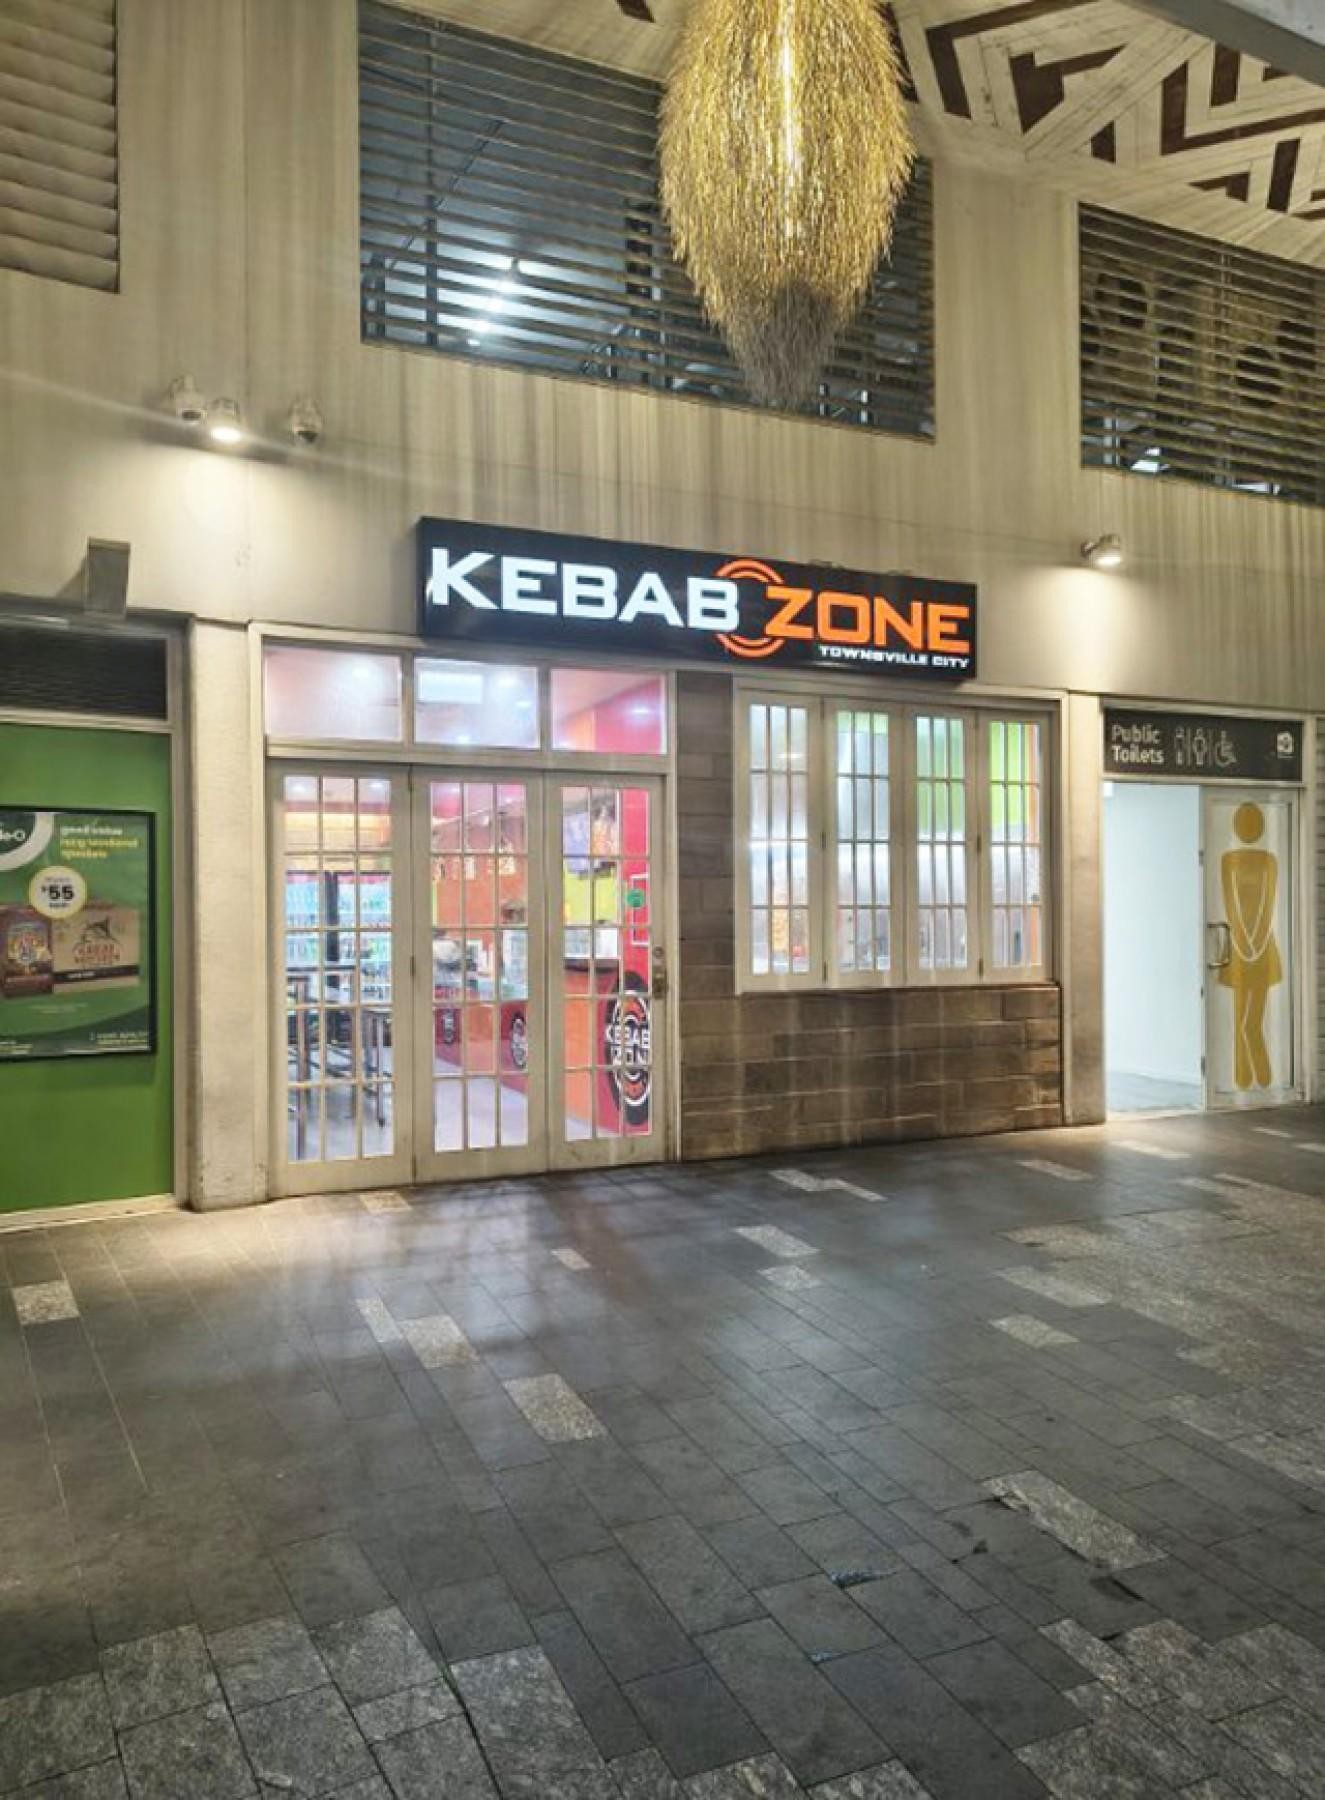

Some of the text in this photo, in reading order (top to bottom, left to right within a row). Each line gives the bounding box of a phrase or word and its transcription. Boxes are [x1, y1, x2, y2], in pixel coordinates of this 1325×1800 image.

[430, 547, 971, 655] KEBAB ZONE
[819, 645, 970, 669] TOWNSVILLE CITY
[1111, 723, 1161, 744] Public
[1111, 744, 1165, 764] Toilets
